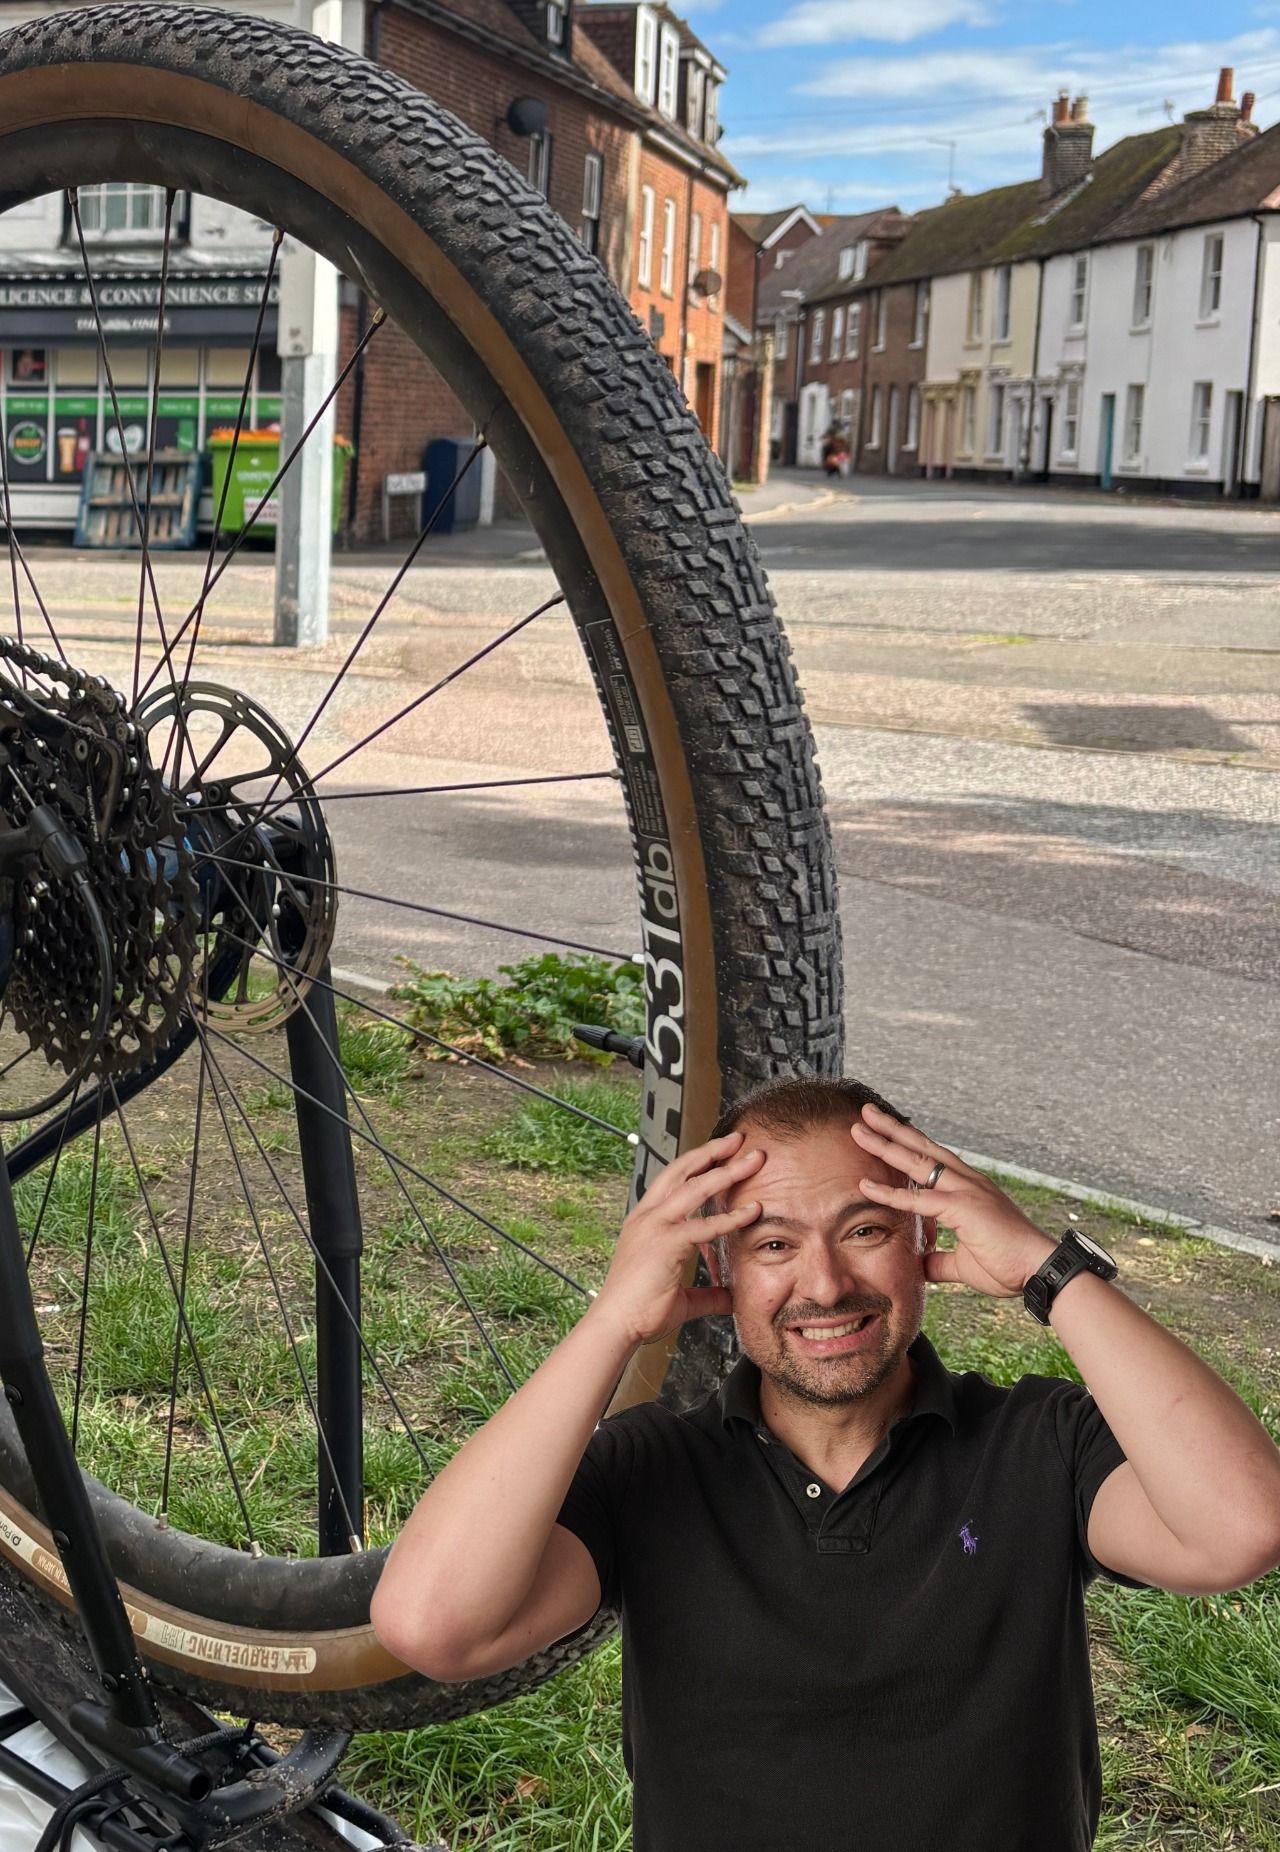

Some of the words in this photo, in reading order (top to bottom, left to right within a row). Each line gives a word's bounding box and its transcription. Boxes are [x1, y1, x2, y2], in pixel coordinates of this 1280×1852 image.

[0, 288, 77, 306] LICENCE
[100, 286, 236, 306] CONVENIENCE
[244, 286, 280, 305] STO
